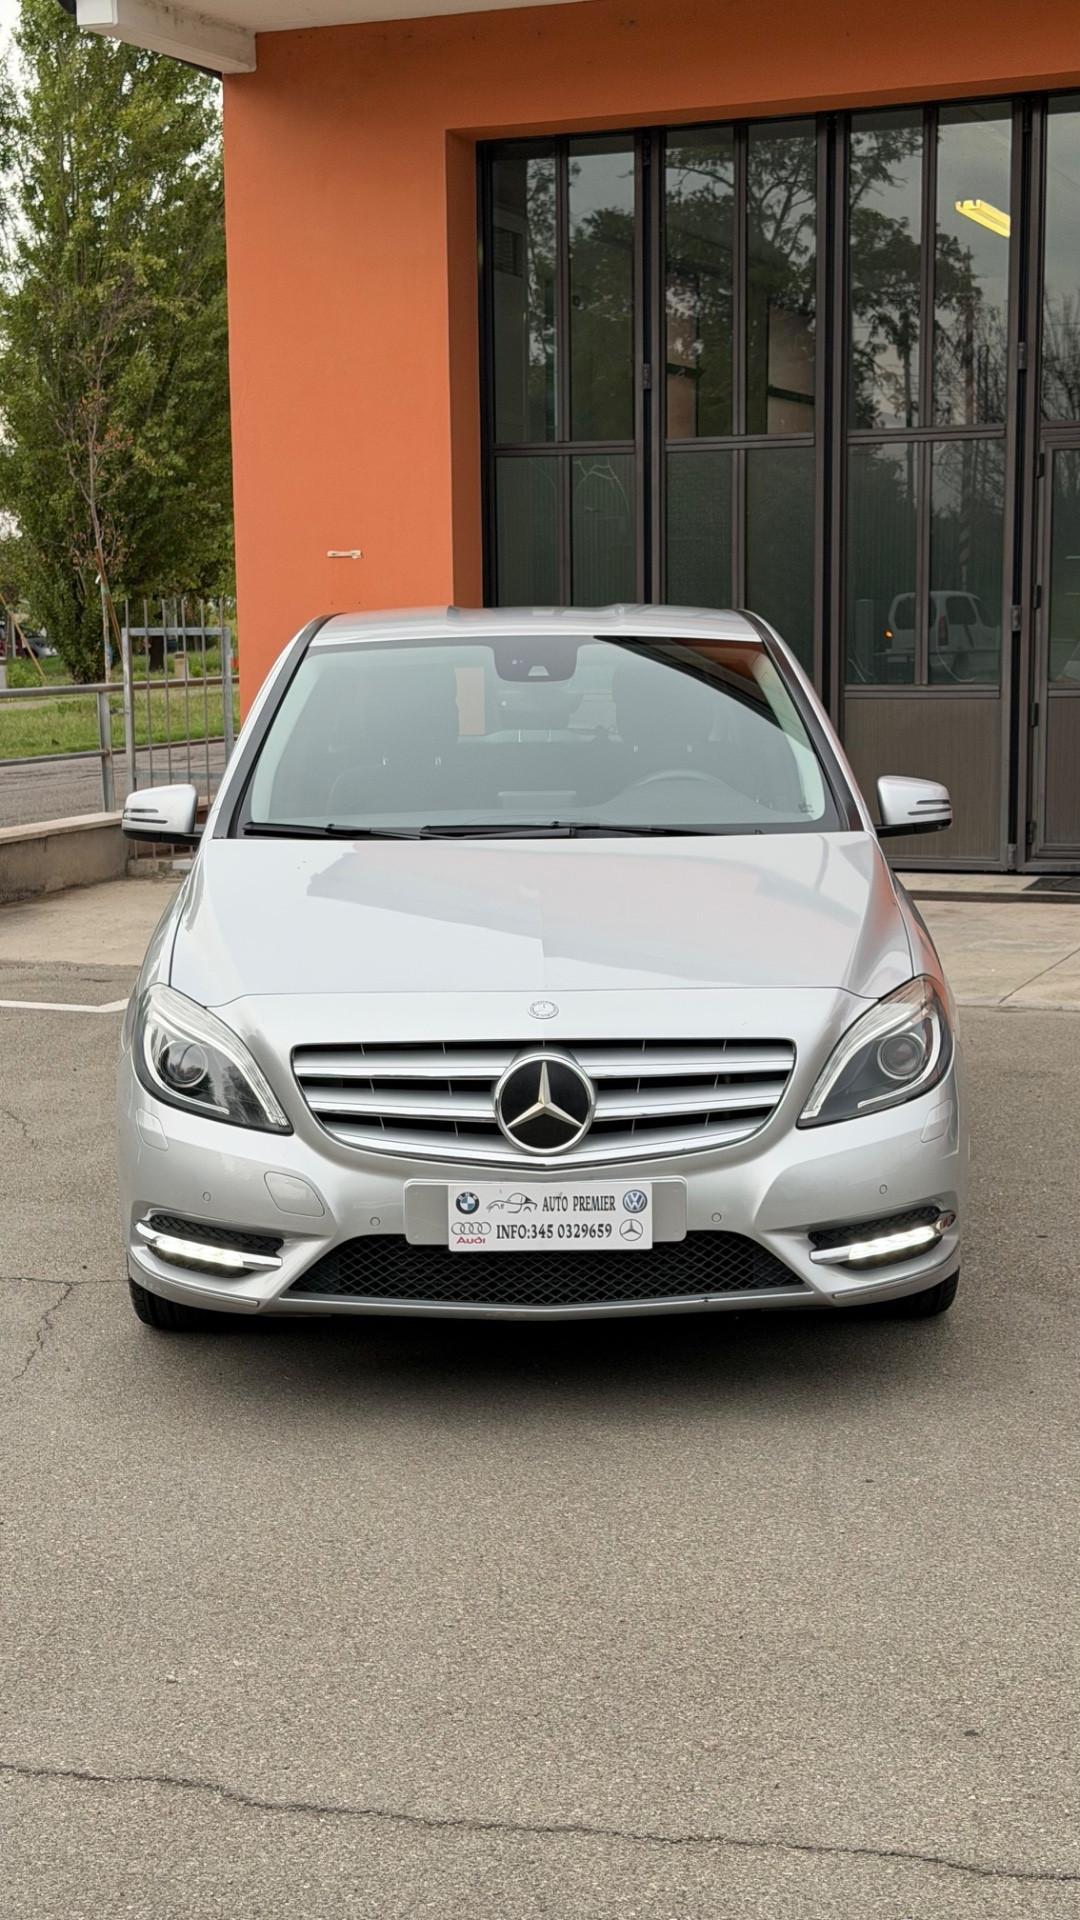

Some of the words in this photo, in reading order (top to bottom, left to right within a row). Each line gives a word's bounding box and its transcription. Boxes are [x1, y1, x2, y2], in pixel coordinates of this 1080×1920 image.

[542, 1195, 568, 1212] AUTO
[573, 1195, 616, 1212] PREMIER
[496, 1224, 553, 1239] INFO:345
[557, 1223, 612, 1238] 0329659
